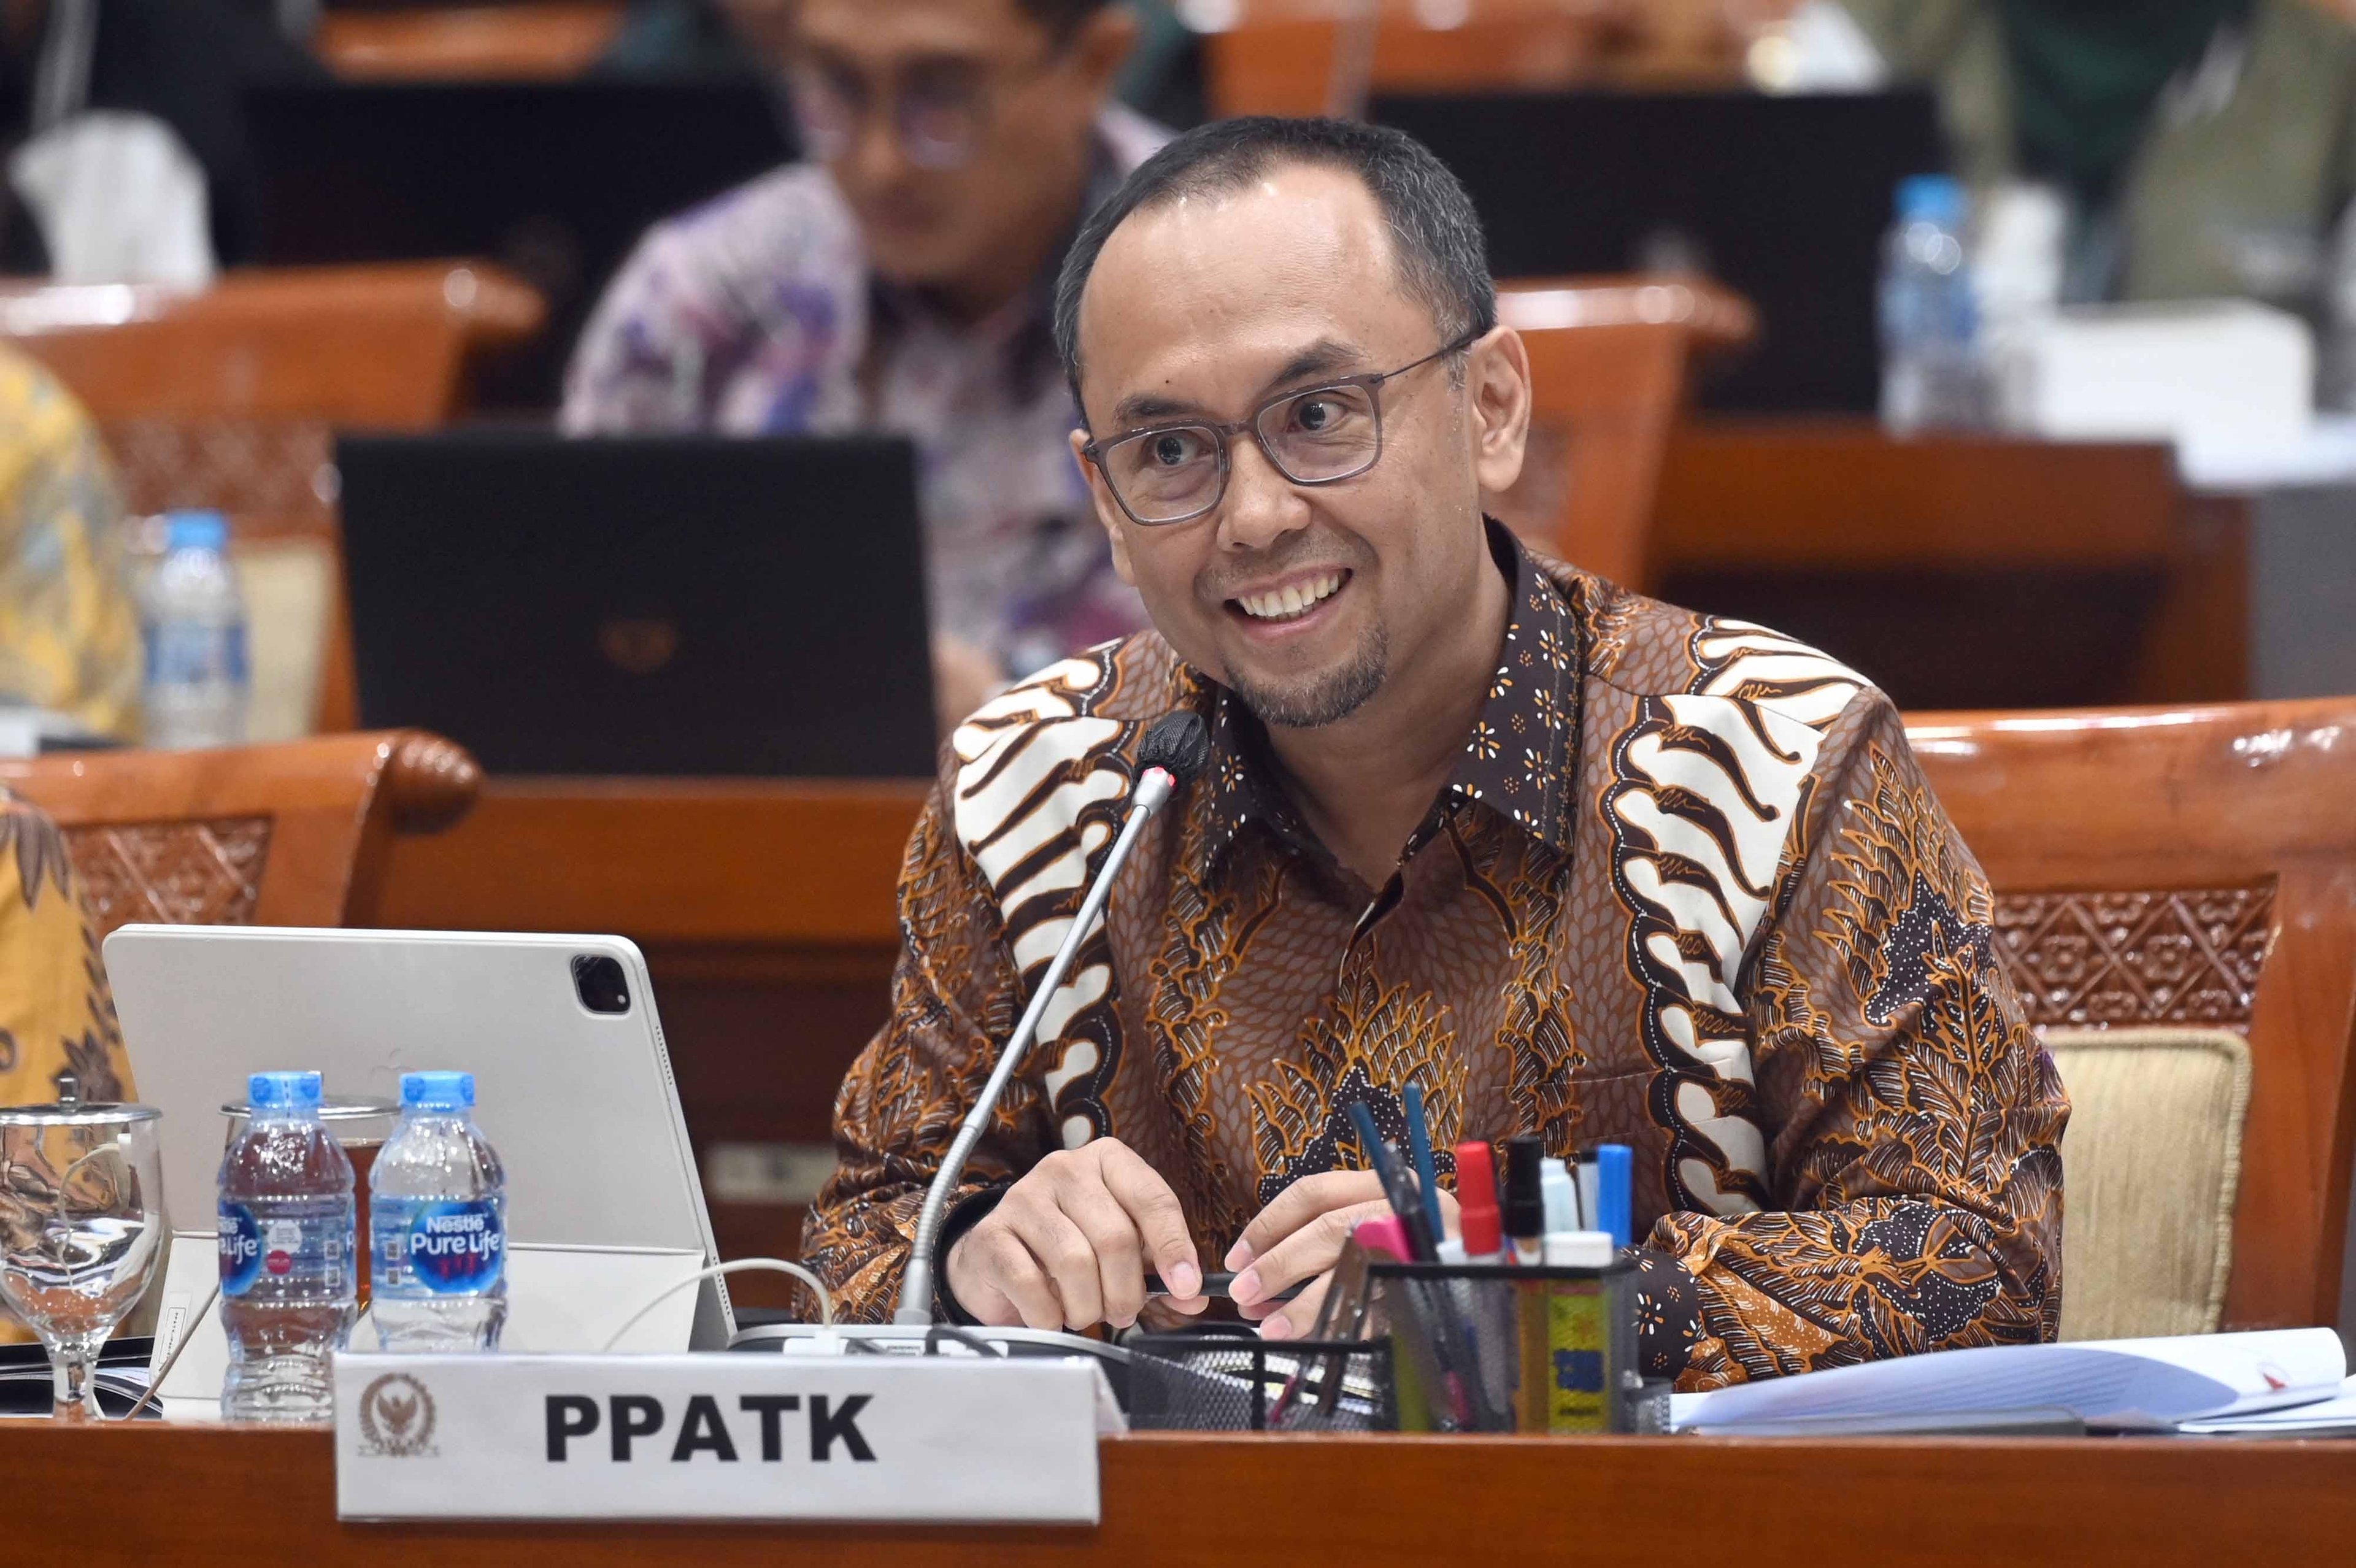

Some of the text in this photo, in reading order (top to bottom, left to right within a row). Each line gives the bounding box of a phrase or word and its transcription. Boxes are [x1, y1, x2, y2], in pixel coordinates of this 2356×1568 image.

[410, 1229, 500, 1261] Pure Life
[545, 1394, 877, 1462] PPATK
